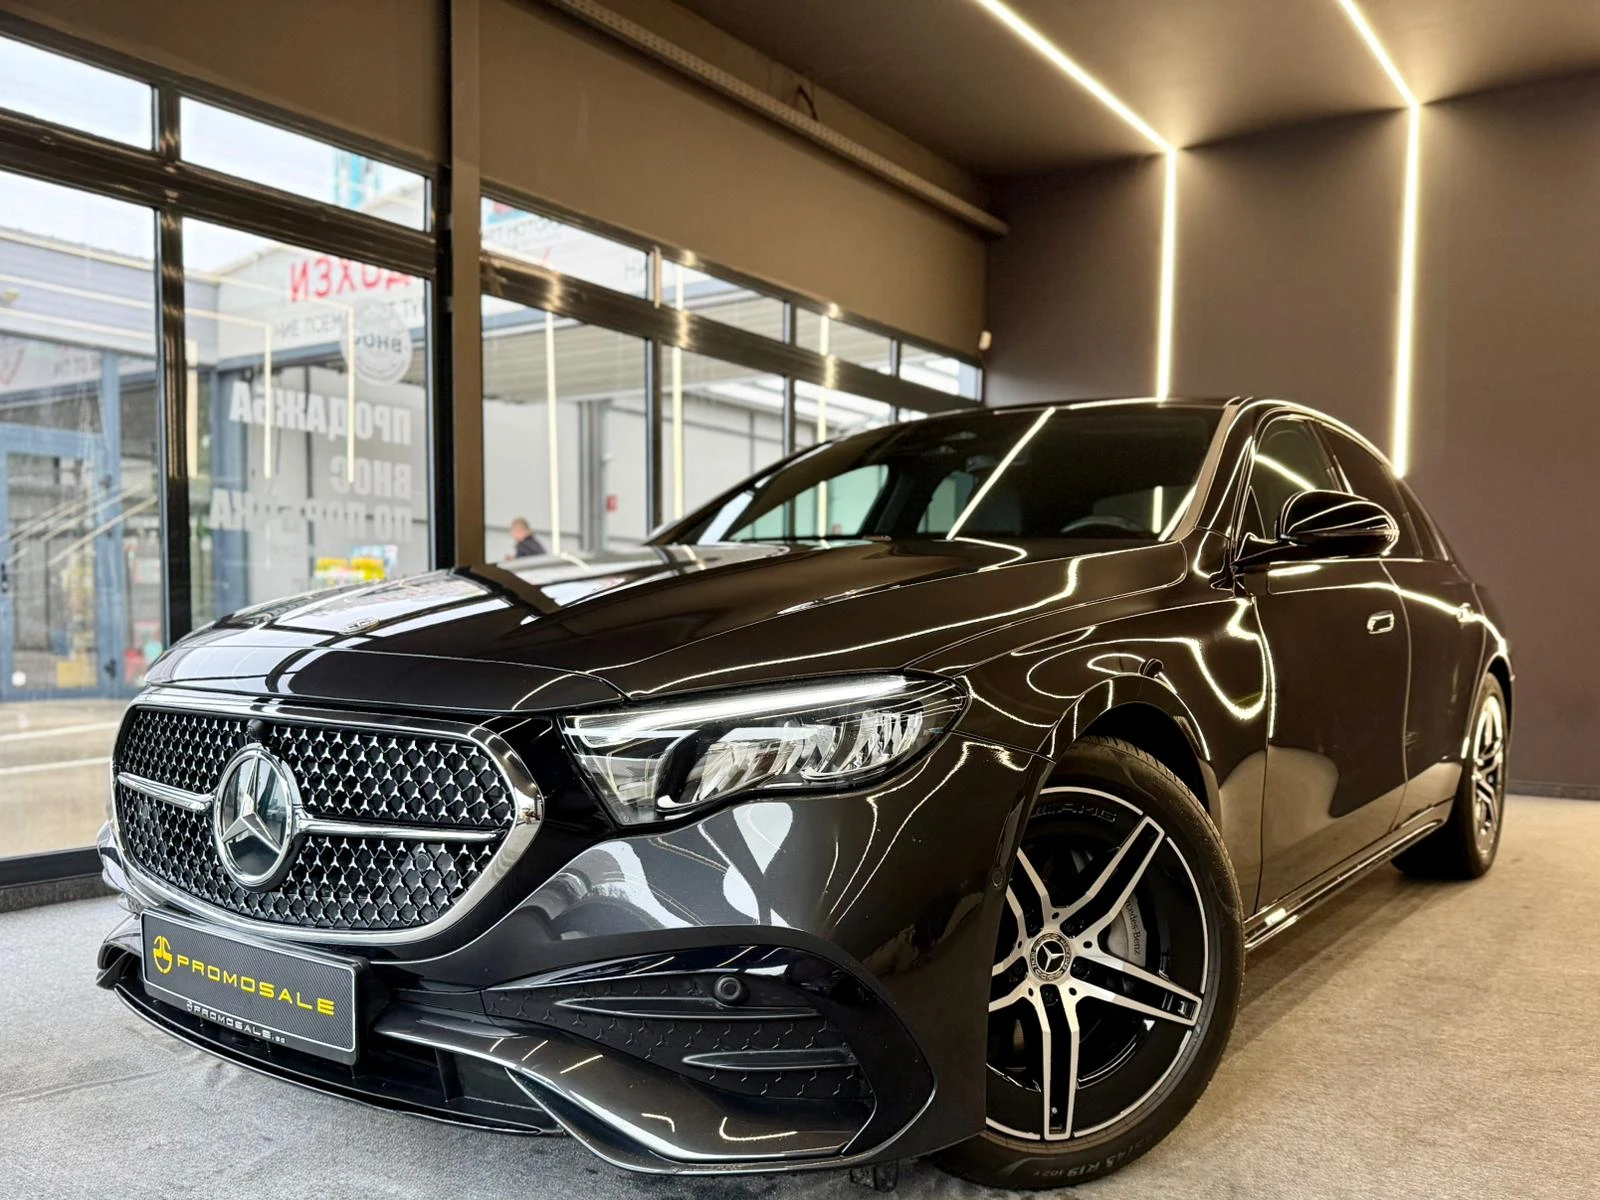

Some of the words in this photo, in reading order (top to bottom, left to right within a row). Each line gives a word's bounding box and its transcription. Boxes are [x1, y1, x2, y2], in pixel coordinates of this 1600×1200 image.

[1125, 903, 1141, 956] cedes-Benz
[177, 954, 335, 1016] PROMOSALE
[1067, 1160, 1101, 1178] R19
